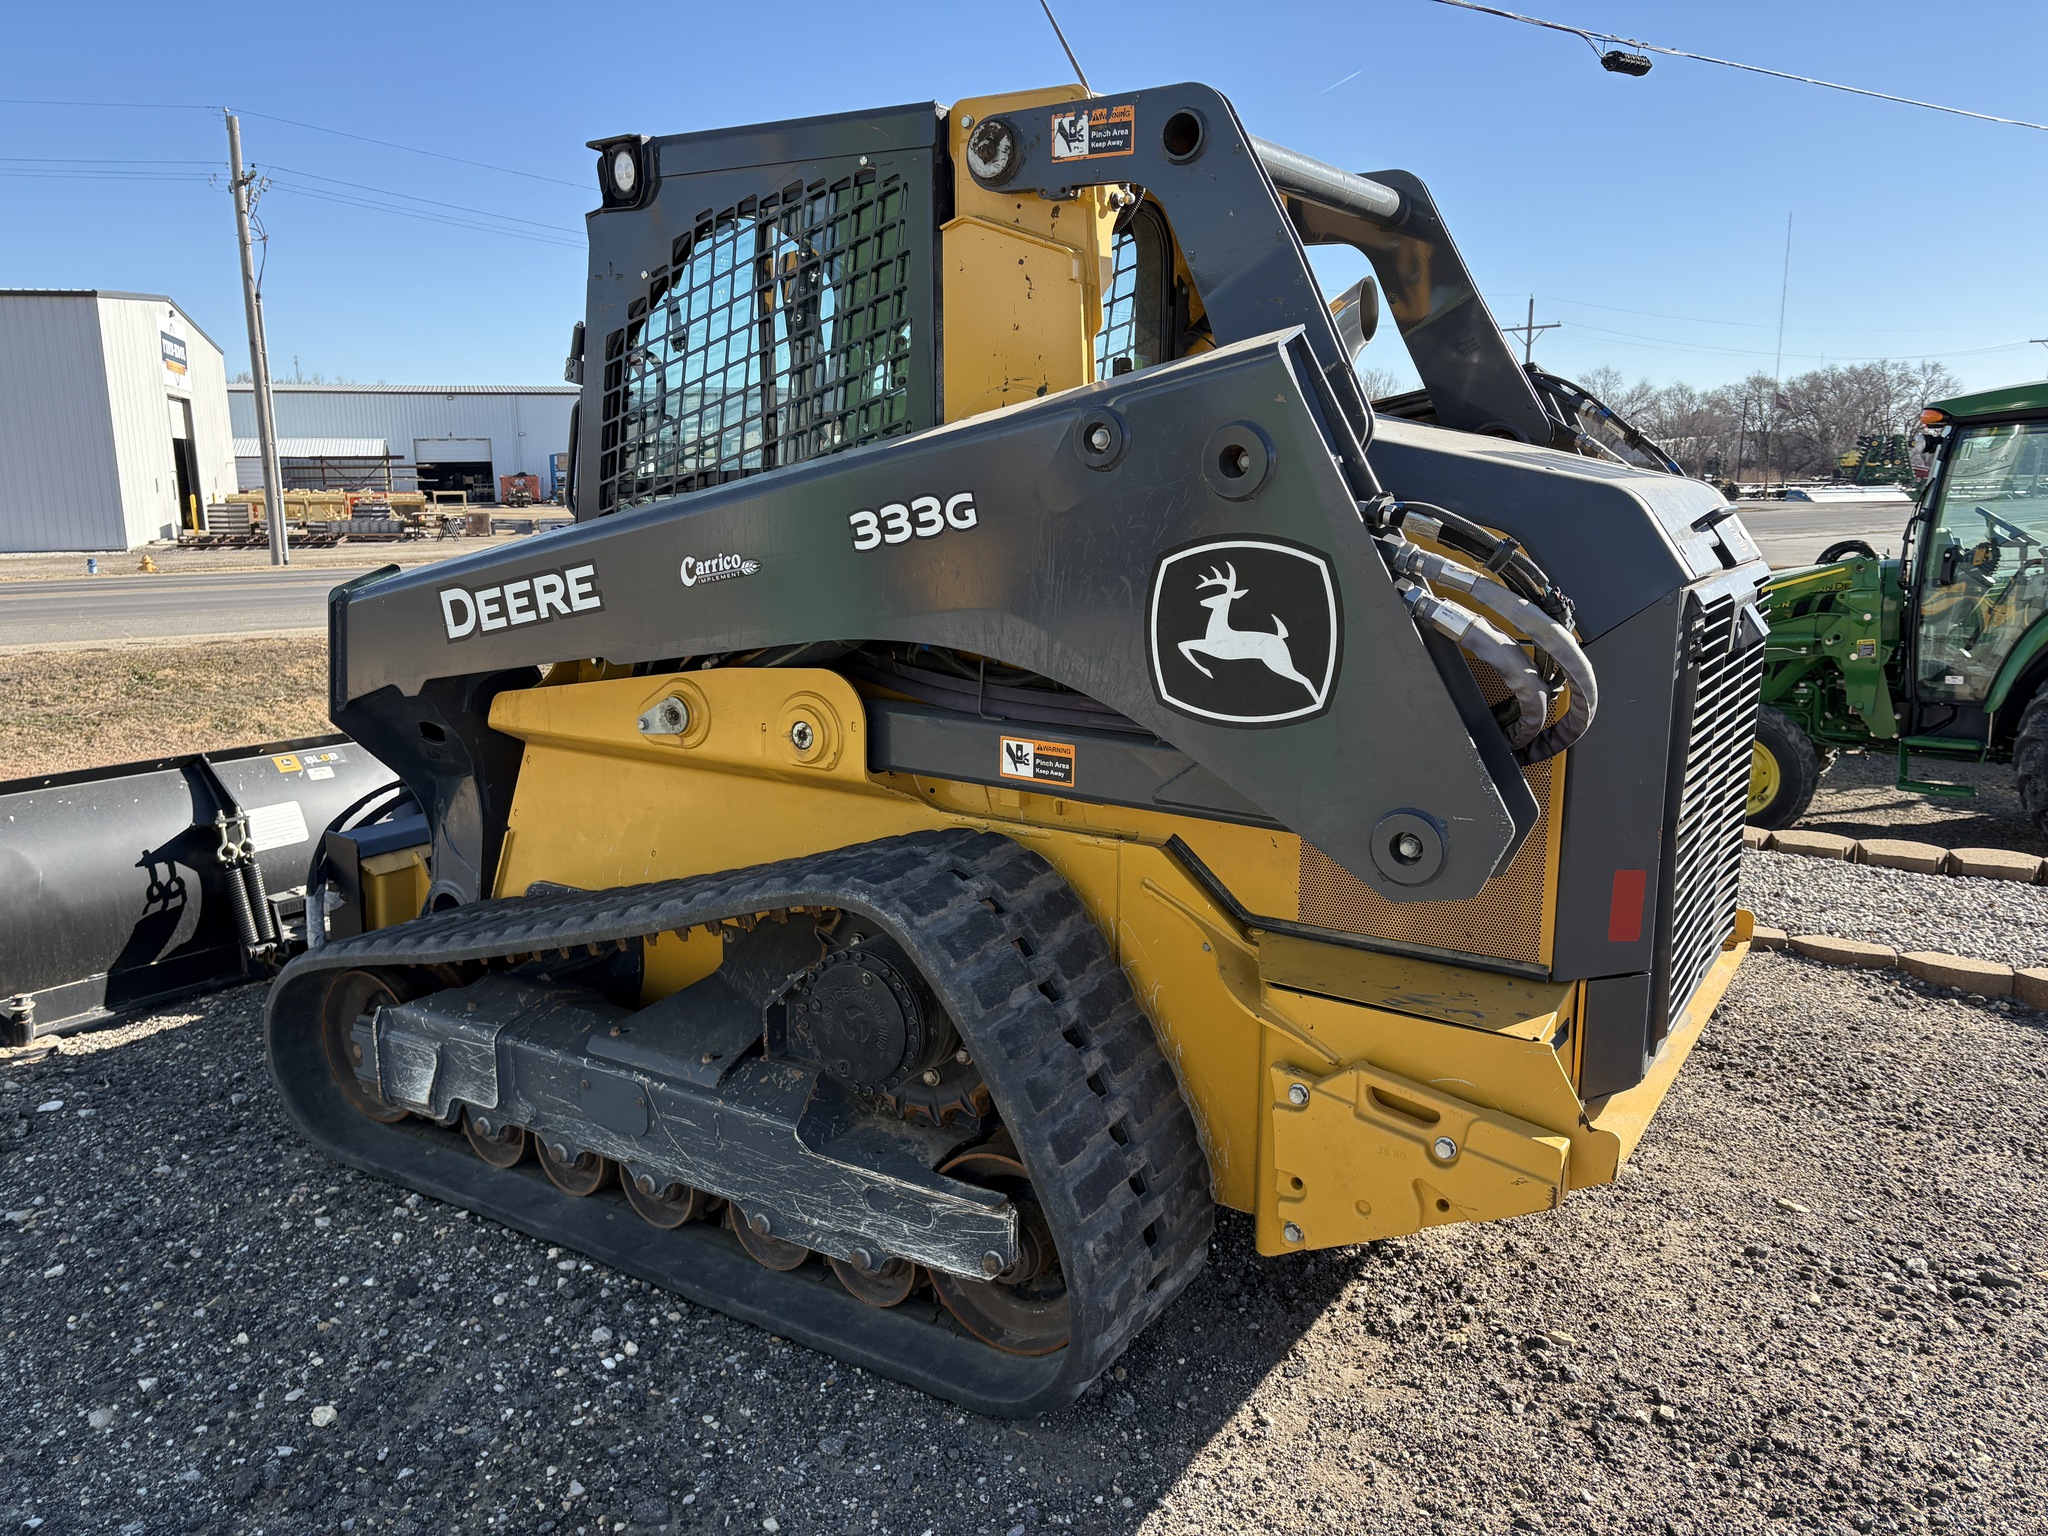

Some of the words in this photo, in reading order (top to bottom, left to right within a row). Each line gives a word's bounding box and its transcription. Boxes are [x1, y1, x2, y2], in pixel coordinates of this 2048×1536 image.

[1091, 130, 1111, 139] Pinch
[1112, 128, 1129, 136] Area
[1091, 141, 1106, 149] Keep
[1107, 139, 1124, 147] Away
[849, 492, 977, 551] 333G
[680, 552, 741, 587] Carrico
[697, 571, 741, 584] IMPLEMENT
[440, 564, 601, 639] DEERE
[1042, 745, 1071, 754] WARNING
[1035, 758, 1054, 768] Pinch
[1054, 761, 1070, 770] Area
[1035, 767, 1050, 775] Keep
[1050, 769, 1065, 778] Away
